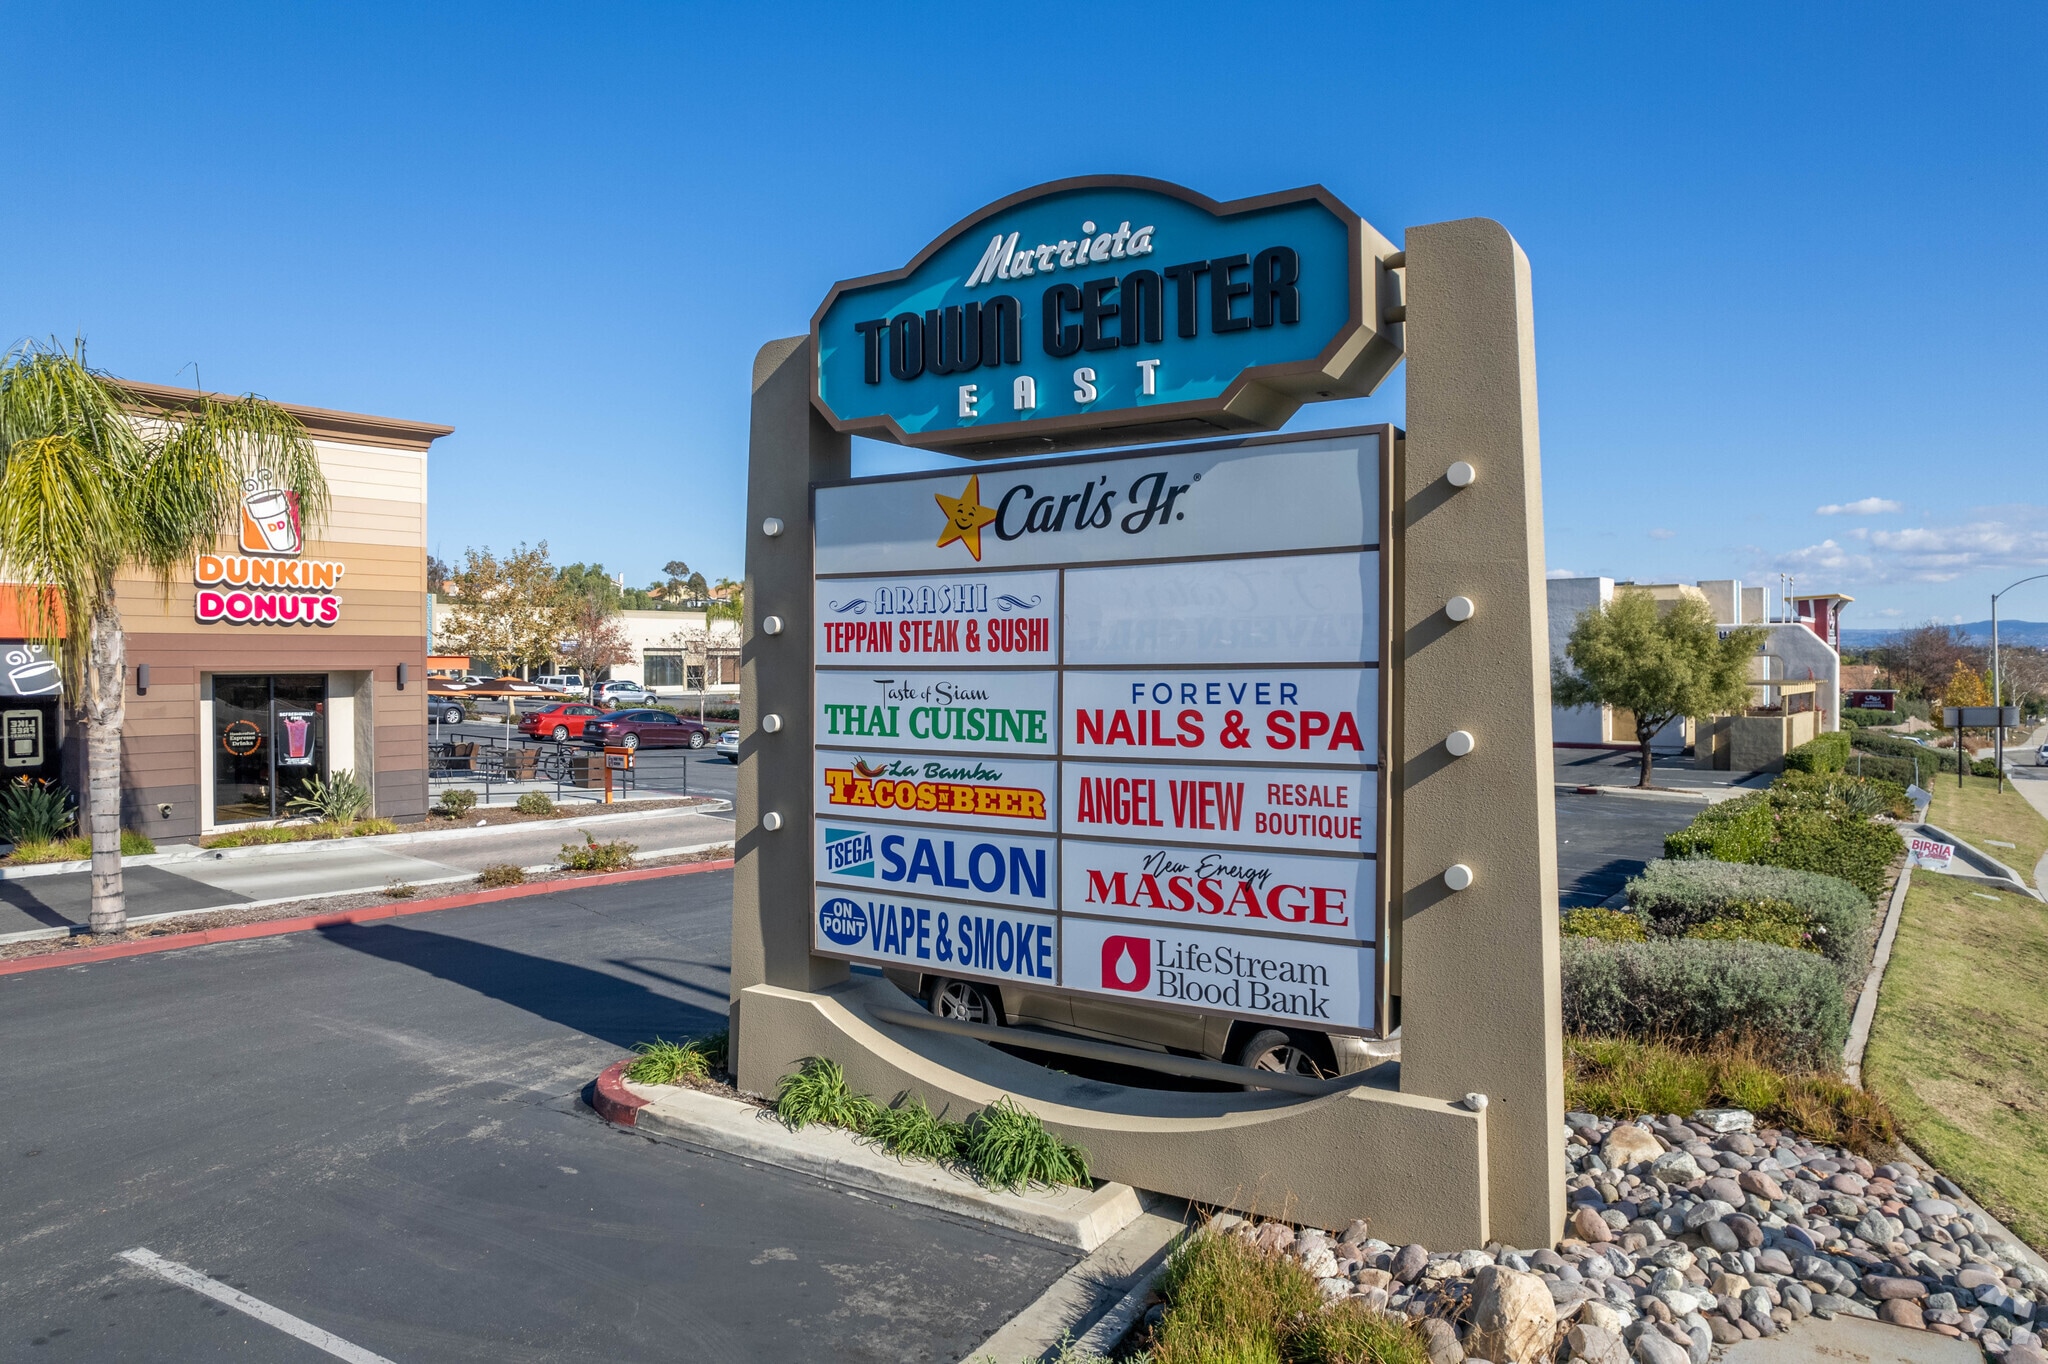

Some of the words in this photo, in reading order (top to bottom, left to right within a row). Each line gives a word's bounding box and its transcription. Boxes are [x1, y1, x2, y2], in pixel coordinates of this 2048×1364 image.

[965, 221, 1155, 287] Murrieta
[855, 294, 1021, 384] TOWN
[1042, 246, 1299, 357] CENTER
[958, 359, 1160, 417] EAST
[267, 520, 285, 532] DD
[994, 476, 1113, 540] Carl's
[197, 555, 344, 588] DUNKIN'
[198, 591, 339, 622] DONUTS
[874, 584, 988, 614] ARASHI
[824, 621, 892, 652] TEPPAN
[899, 620, 959, 652] STEAK
[965, 619, 981, 652] &
[987, 618, 1049, 652] SUSHI
[873, 679, 918, 709] Taste
[921, 686, 931, 703] of
[934, 682, 989, 705] Siam
[1132, 683, 1298, 706] FOREVER
[824, 704, 900, 737] THAI
[909, 707, 1047, 743] CUISINE
[1076, 709, 1205, 747] NAILS
[1219, 709, 1251, 749] &
[1266, 709, 1365, 751] SPA
[888, 760, 919, 777] La
[923, 762, 1002, 781] Bamba
[1077, 777, 1163, 827] ANGEL
[1169, 780, 1245, 831] VIEW
[1267, 783, 1348, 808] RESALE
[1255, 812, 1362, 839] BOUTIQUE
[826, 834, 873, 870] TSEGA
[1911, 839, 1951, 856] BIRRIA
[881, 835, 1046, 898] SALON
[1143, 851, 1189, 878] New
[1195, 854, 1272, 891] Energy
[833, 901, 852, 918] ON
[1085, 869, 1348, 926] MASSAGE
[823, 917, 865, 937] POINT
[868, 902, 930, 959] VAPE
[936, 912, 953, 962] &
[958, 915, 1052, 979] SMOKE
[1156, 939, 1330, 986] LifeStream
[1156, 970, 1241, 1007] Blood
[1248, 981, 1330, 1019] Bank
